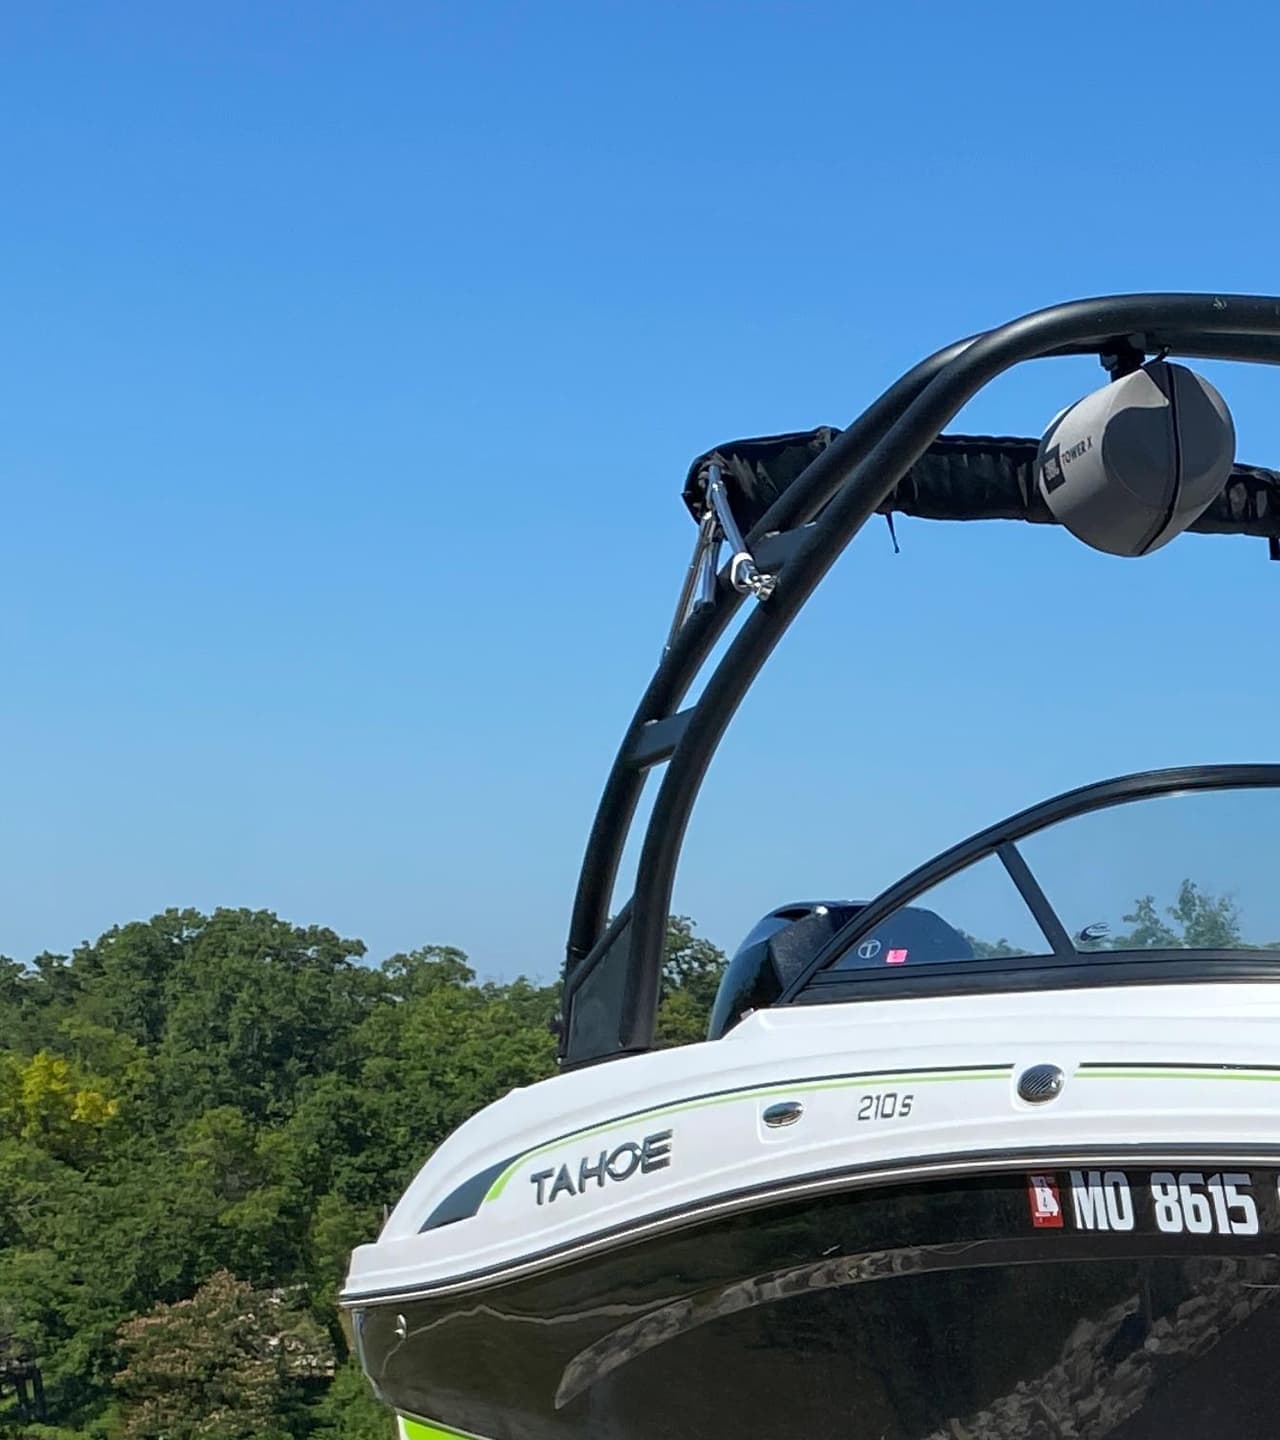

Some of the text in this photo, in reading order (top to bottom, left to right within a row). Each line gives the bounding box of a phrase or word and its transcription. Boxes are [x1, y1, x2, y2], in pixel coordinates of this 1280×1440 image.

[1061, 440, 1087, 465] TOWER
[530, 1128, 674, 1206] TAHOE
[1068, 1169, 1135, 1232] MO
[1150, 1172, 1260, 1236] 8615
